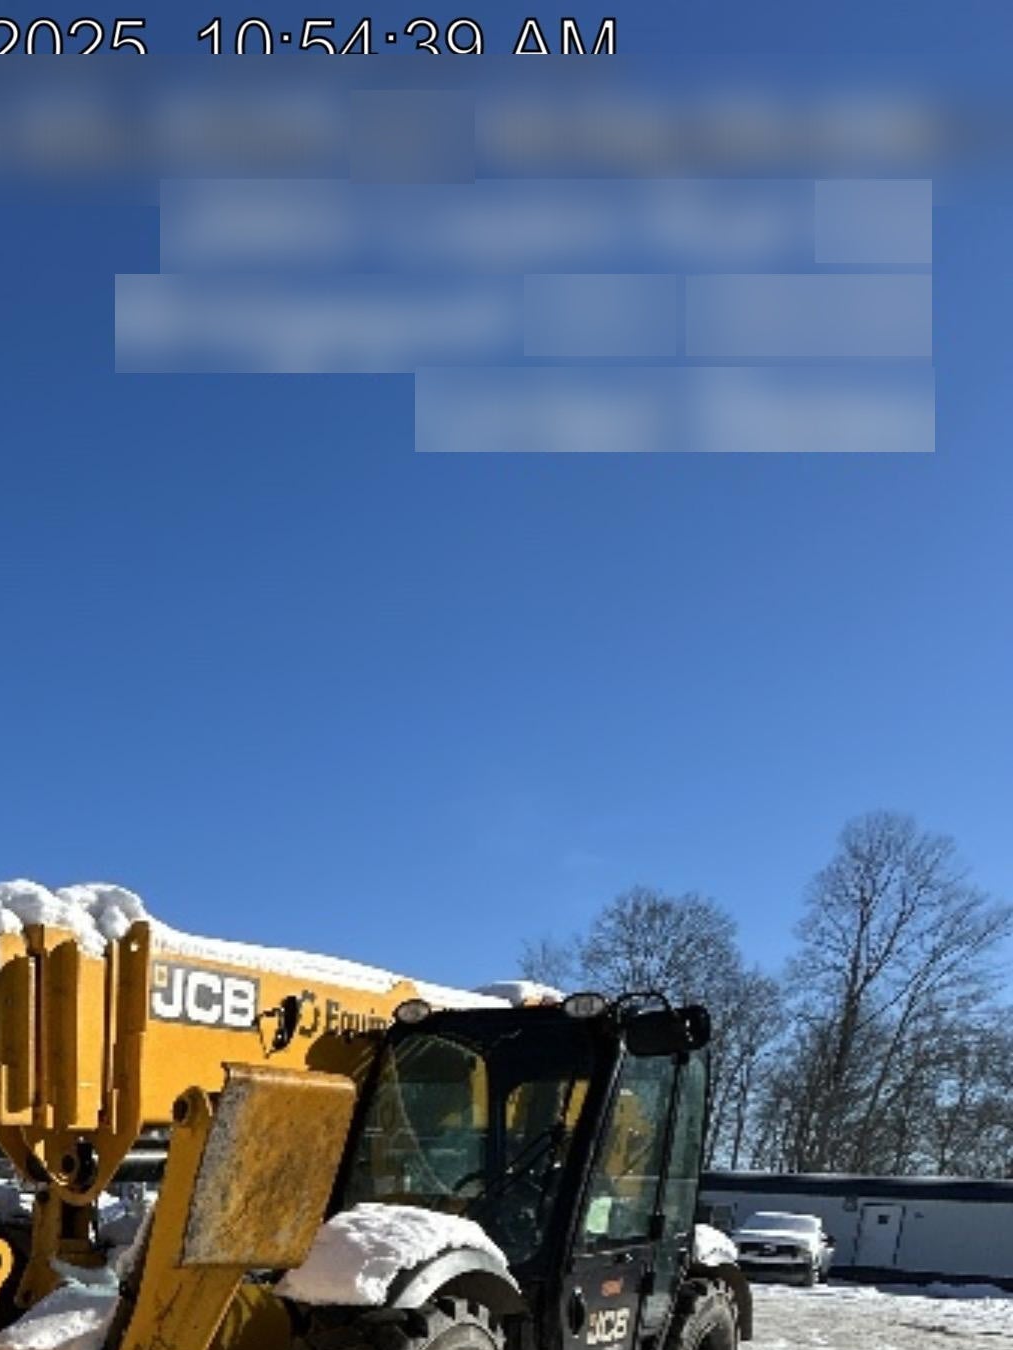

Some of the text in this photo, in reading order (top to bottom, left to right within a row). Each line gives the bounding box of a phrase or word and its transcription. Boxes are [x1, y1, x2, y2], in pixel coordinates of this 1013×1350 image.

[151, 967, 256, 1028] JCB
[325, 998, 391, 1034] Equip
[586, 1306, 630, 1345] JCB
